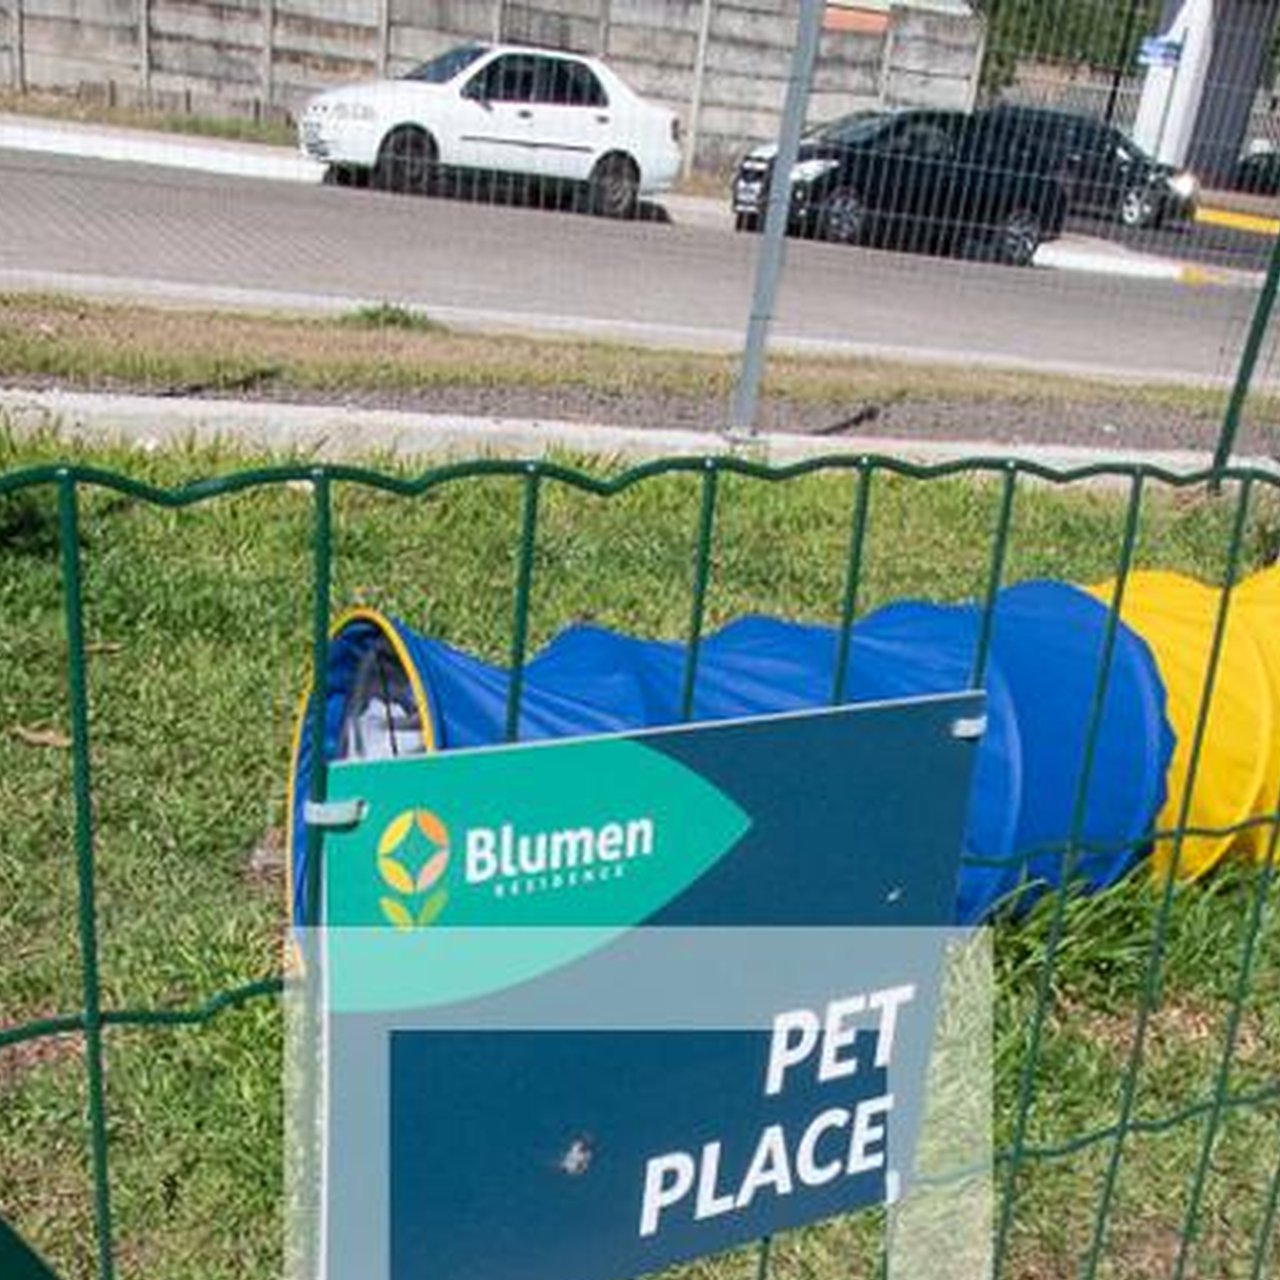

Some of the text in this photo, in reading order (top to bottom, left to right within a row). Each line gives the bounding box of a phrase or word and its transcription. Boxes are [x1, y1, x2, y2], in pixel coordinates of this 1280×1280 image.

[465, 818, 653, 882] Blumen
[765, 984, 915, 1096] PET
[639, 1094, 894, 1237] PLACE
